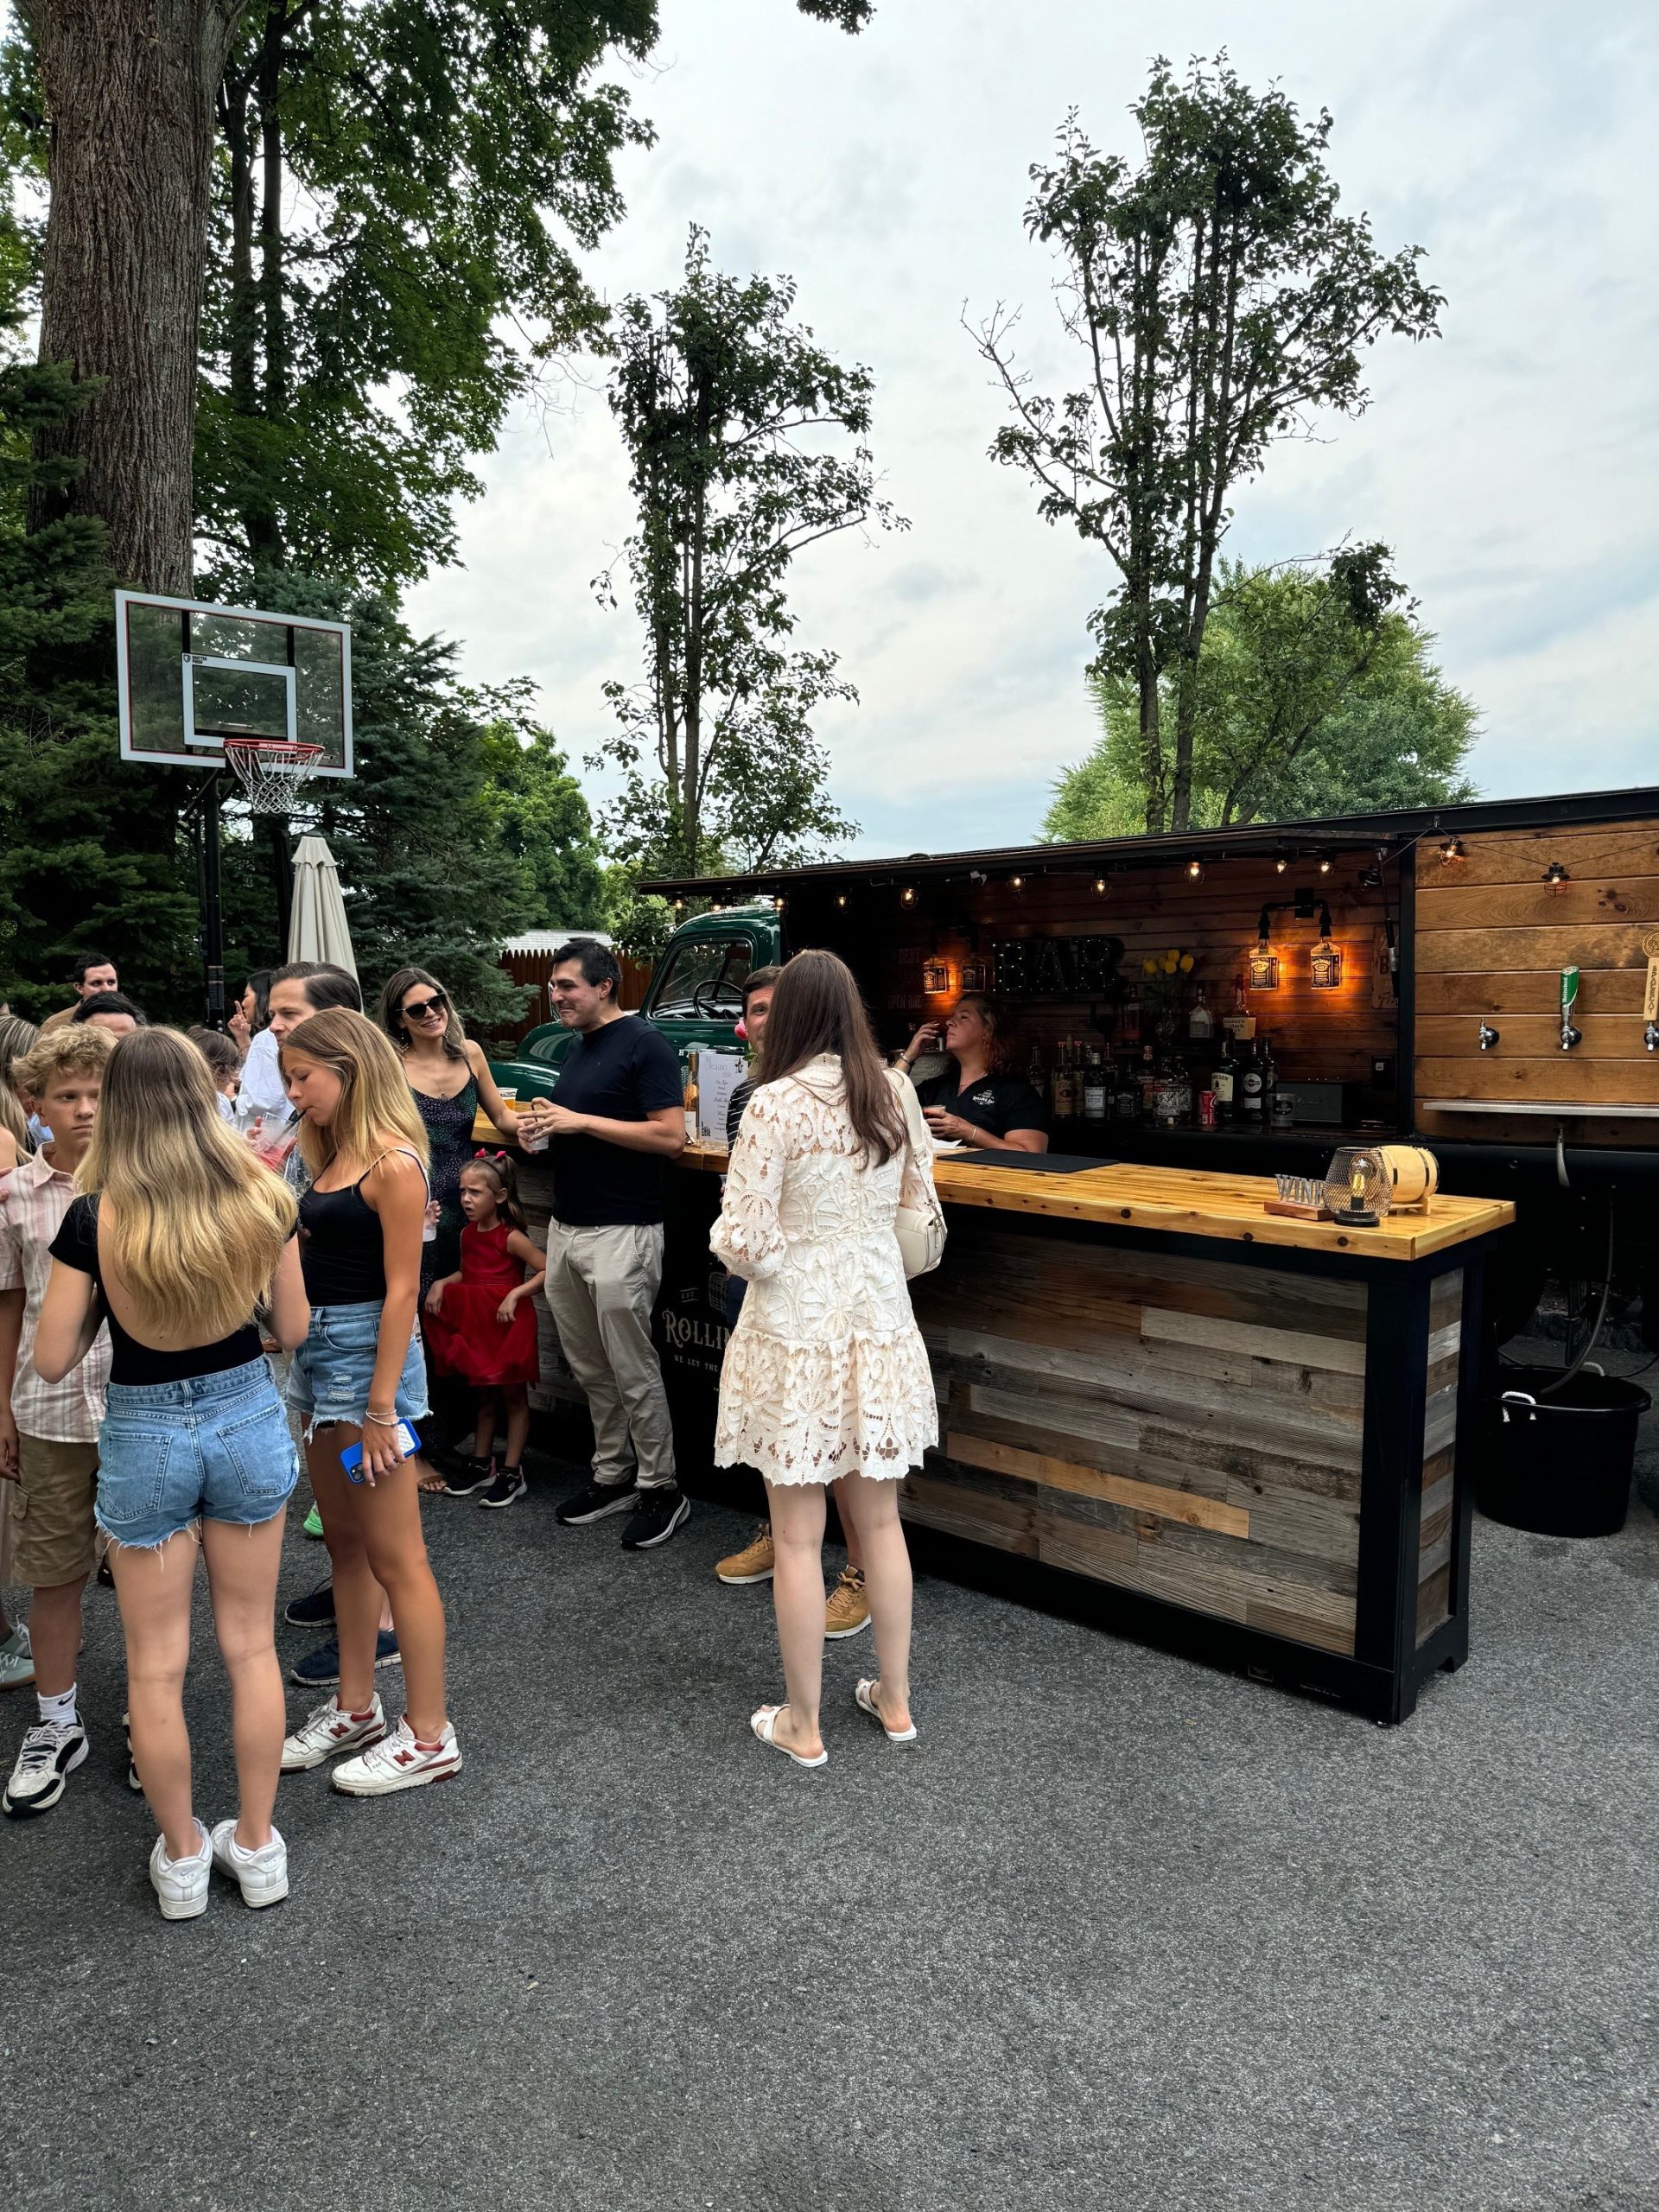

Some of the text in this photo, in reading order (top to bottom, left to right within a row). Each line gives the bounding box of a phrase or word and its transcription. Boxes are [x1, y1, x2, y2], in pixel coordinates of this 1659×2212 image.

[993, 938, 1121, 993] BAR
[662, 1308, 732, 1350] ROLLIN
[674, 1355, 718, 1372] WE LET THE
